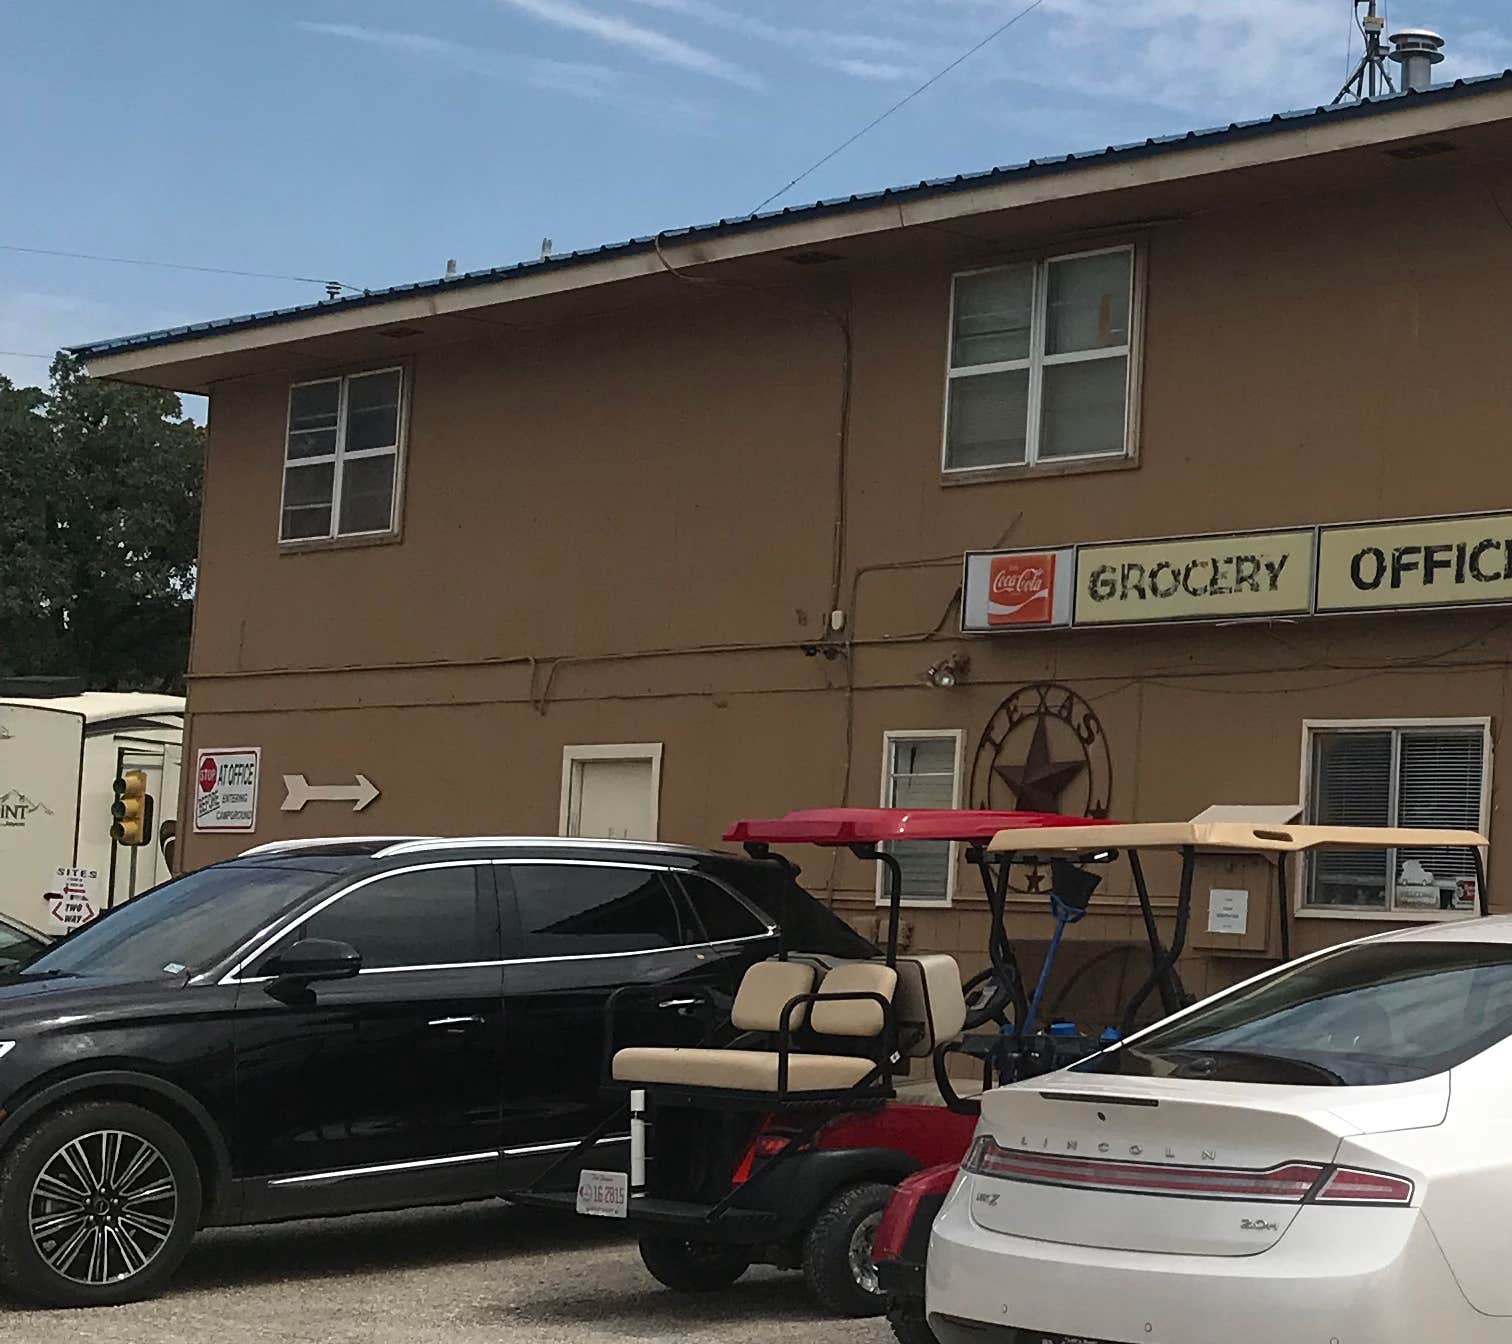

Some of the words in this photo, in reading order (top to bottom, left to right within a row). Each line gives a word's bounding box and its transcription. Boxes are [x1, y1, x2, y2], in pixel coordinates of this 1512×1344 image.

[993, 567, 1043, 592] Coca-Cola
[1088, 553, 1290, 602] GROCERY
[979, 684, 1102, 752] TEXAS
[200, 768, 217, 782] STOP
[218, 764, 228, 786] AT
[228, 762, 254, 786] OFFICE
[57, 867, 98, 879] SITES
[64, 915, 82, 924] WAY
[65, 903, 83, 913] TWO
[1020, 1136, 1217, 1161] LINCOLN
